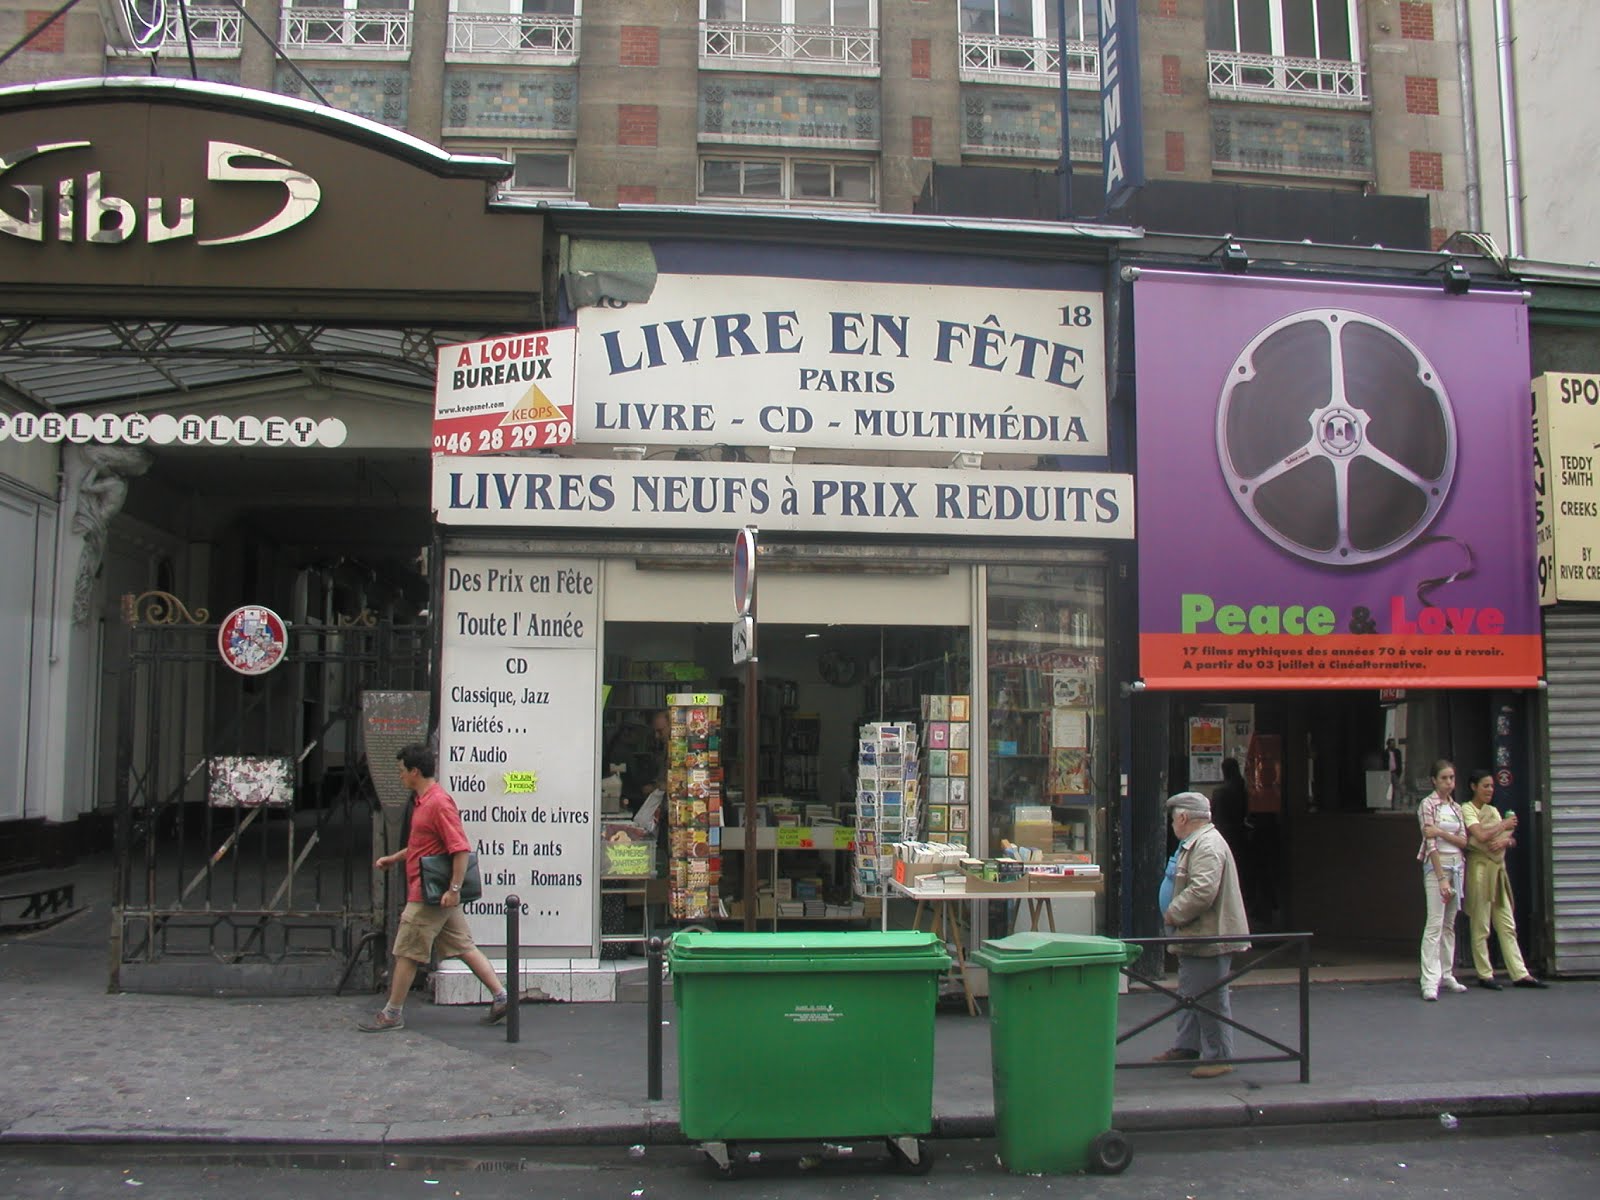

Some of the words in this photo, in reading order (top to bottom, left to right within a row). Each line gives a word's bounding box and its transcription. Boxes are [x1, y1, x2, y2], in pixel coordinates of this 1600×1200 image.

[1058, 305, 1092, 327] 18
[457, 347, 472, 367] A
[480, 336, 549, 364] LOUER
[600, 311, 804, 375] LIVRE
[829, 312, 910, 358] EN
[934, 314, 1085, 391] FÊTE
[453, 358, 552, 390] BUREAUX
[799, 367, 895, 394] PARIS
[1560, 377, 1600, 406] SPO
[438, 401, 505, 416] www.keopsnet.com
[512, 406, 554, 420] KEOPS
[182, 419, 313, 442] ALLEY
[595, 402, 716, 431] LIVRE
[759, 405, 814, 433] CD
[854, 405, 1089, 443] MULTIMÉDIA
[434, 435, 447, 448] 01
[446, 432, 472, 454] 46
[478, 428, 503, 451] 28
[510, 425, 537, 448] 29
[544, 421, 572, 445] 29
[1560, 456, 1593, 471] TEDDY
[1561, 471, 1593, 487] SMITH
[449, 473, 615, 512] LIVRES
[632, 475, 770, 515] NEUFS
[781, 476, 799, 516] à
[812, 480, 919, 518] PRIX
[935, 483, 1120, 524] REDUITS
[1560, 501, 1597, 517] CREEKS
[1582, 547, 1592, 561] BY
[449, 567, 481, 592] Des
[487, 568, 524, 593] Prix
[530, 575, 550, 593] en
[556, 568, 593, 595] Fête
[1560, 564, 1584, 580] RIVER
[457, 611, 507, 636] Toute
[527, 611, 584, 638] Année
[1181, 593, 1336, 636] Peace
[1348, 605, 1378, 635] &
[1390, 595, 1506, 636] Love
[1183, 647, 1199, 656] 17
[1202, 646, 1234, 656] films
[1237, 646, 1303, 658] mythiques
[1307, 646, 1328, 656] des
[1331, 646, 1375, 656] années
[1378, 647, 1396, 656] 70
[1410, 646, 1433, 656] voir
[1436, 648, 1451, 656] ou
[1454, 646, 1462, 656] à
[1465, 646, 1504, 656] revoir.
[506, 658, 528, 674] CD
[1183, 660, 1193, 670] A
[1196, 660, 1233, 672] partir
[1237, 660, 1253, 670] du
[1256, 660, 1275, 670] 03
[1278, 660, 1315, 672] juillet
[1318, 660, 1326, 670] à
[1329, 659, 1427, 670] Cinéalternative.
[451, 686, 517, 708] Classique,
[521, 688, 550, 705] Jazz
[449, 746, 466, 763] K7
[470, 746, 508, 763] Audio
[449, 775, 486, 793] Vidéo
[458, 806, 487, 823] rand
[491, 806, 527, 823] Choix
[531, 806, 547, 823] de
[551, 806, 590, 824] Livres
[531, 869, 582, 887] Romans
